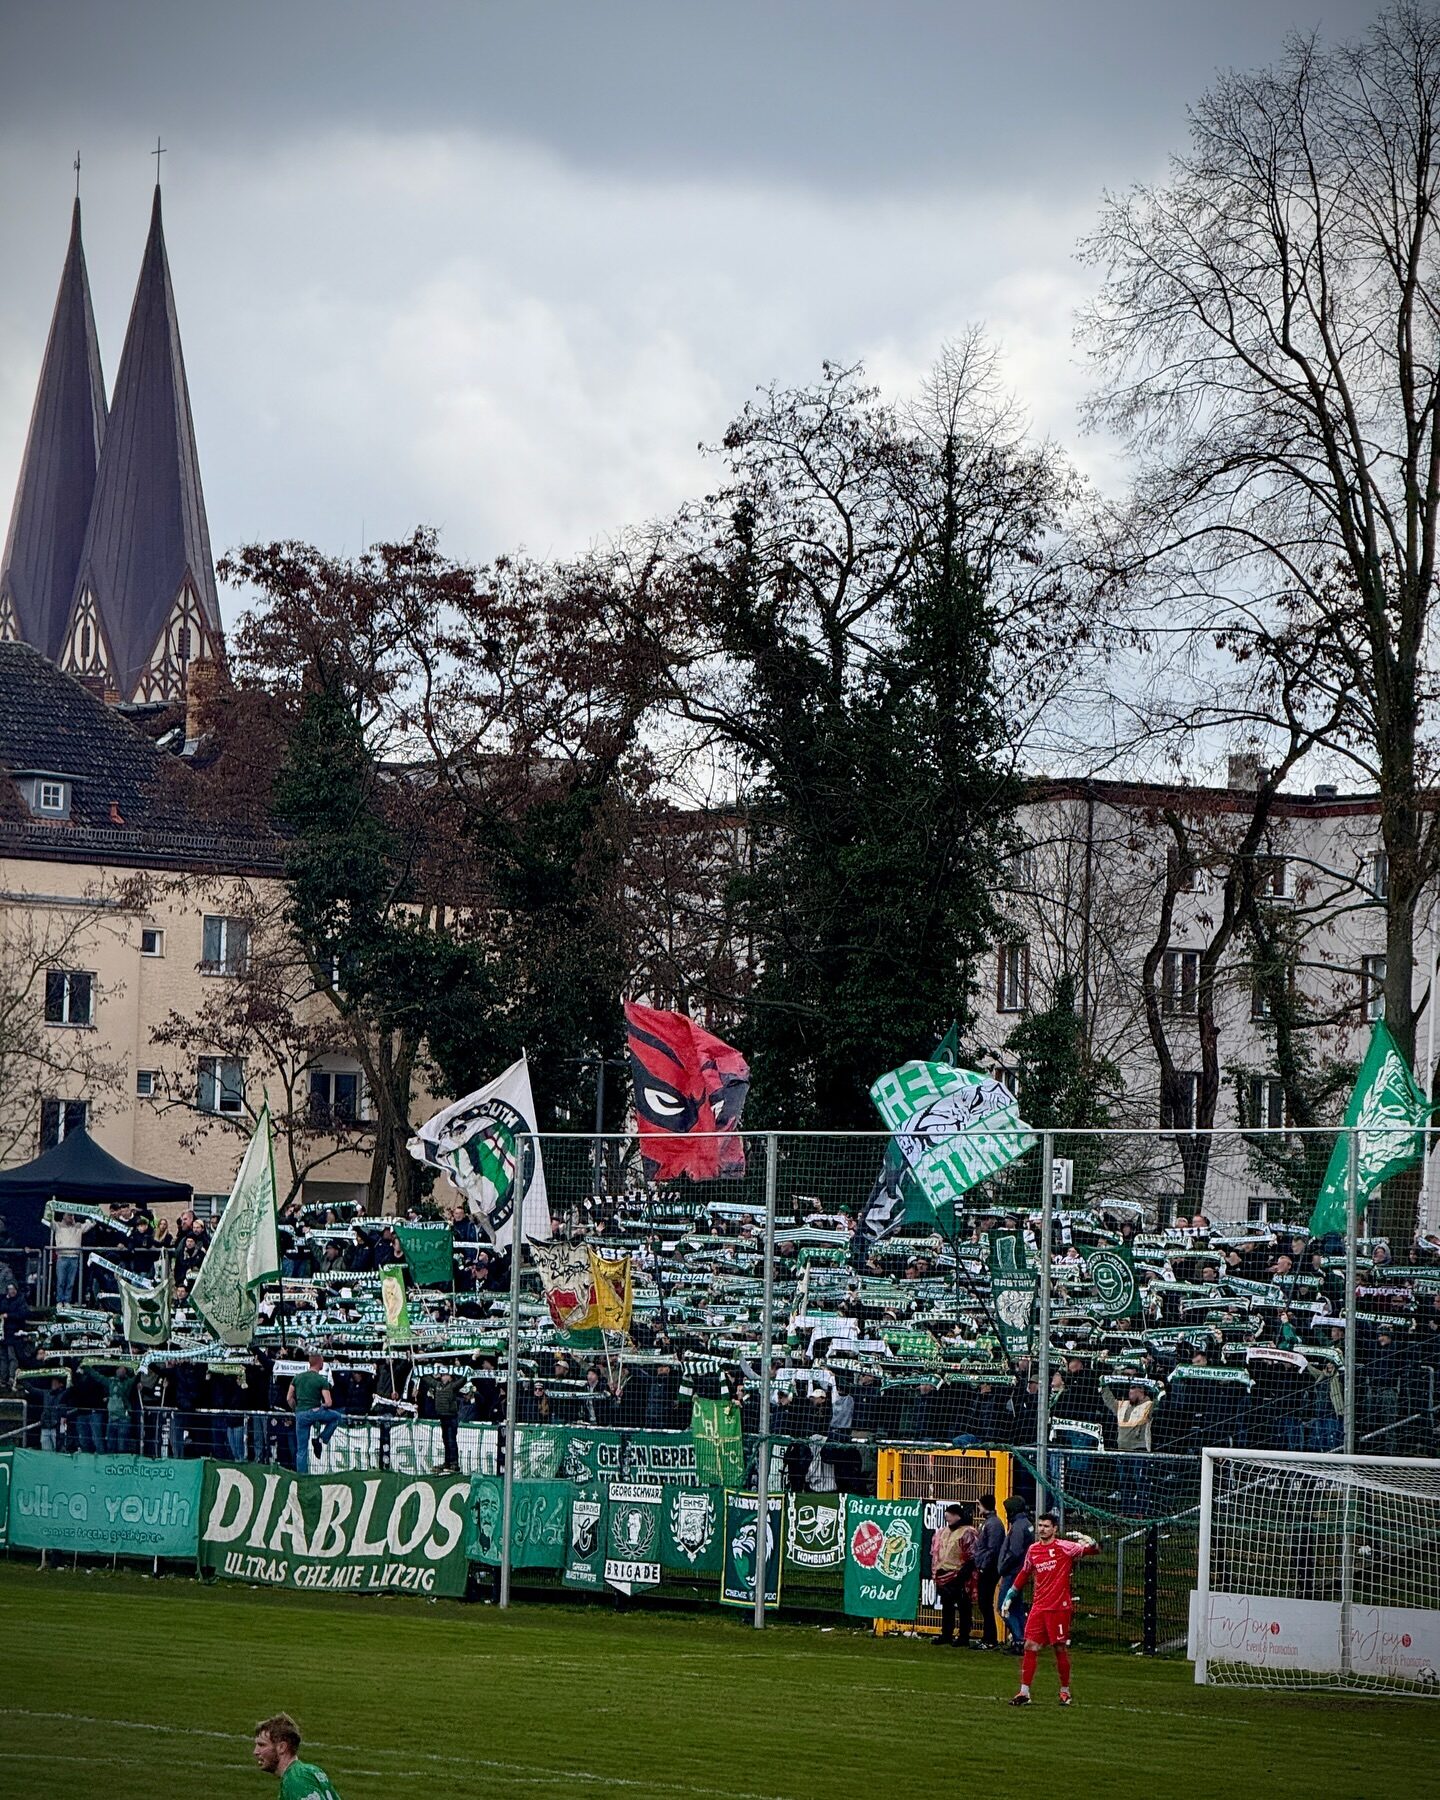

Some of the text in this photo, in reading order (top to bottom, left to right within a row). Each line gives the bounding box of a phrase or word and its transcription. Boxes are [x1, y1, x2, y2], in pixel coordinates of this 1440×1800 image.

[1188, 1367, 1240, 1378] CHEMIE LEIPZIG
[743, 1380, 791, 1391] CHMIE
[650, 1445, 697, 1469] REPRE
[611, 1486, 632, 1497] GEORG
[104, 1490, 190, 1527] youth
[202, 1468, 471, 1560] DIABLOS
[849, 1500, 920, 1517] Bierstand
[797, 1551, 836, 1563] KOMBINAT
[224, 1551, 288, 1583] ULTRAS
[293, 1564, 366, 1589] CHEMIE
[606, 1562, 659, 1580] BRIGADE
[860, 1584, 902, 1601] Pöbel
